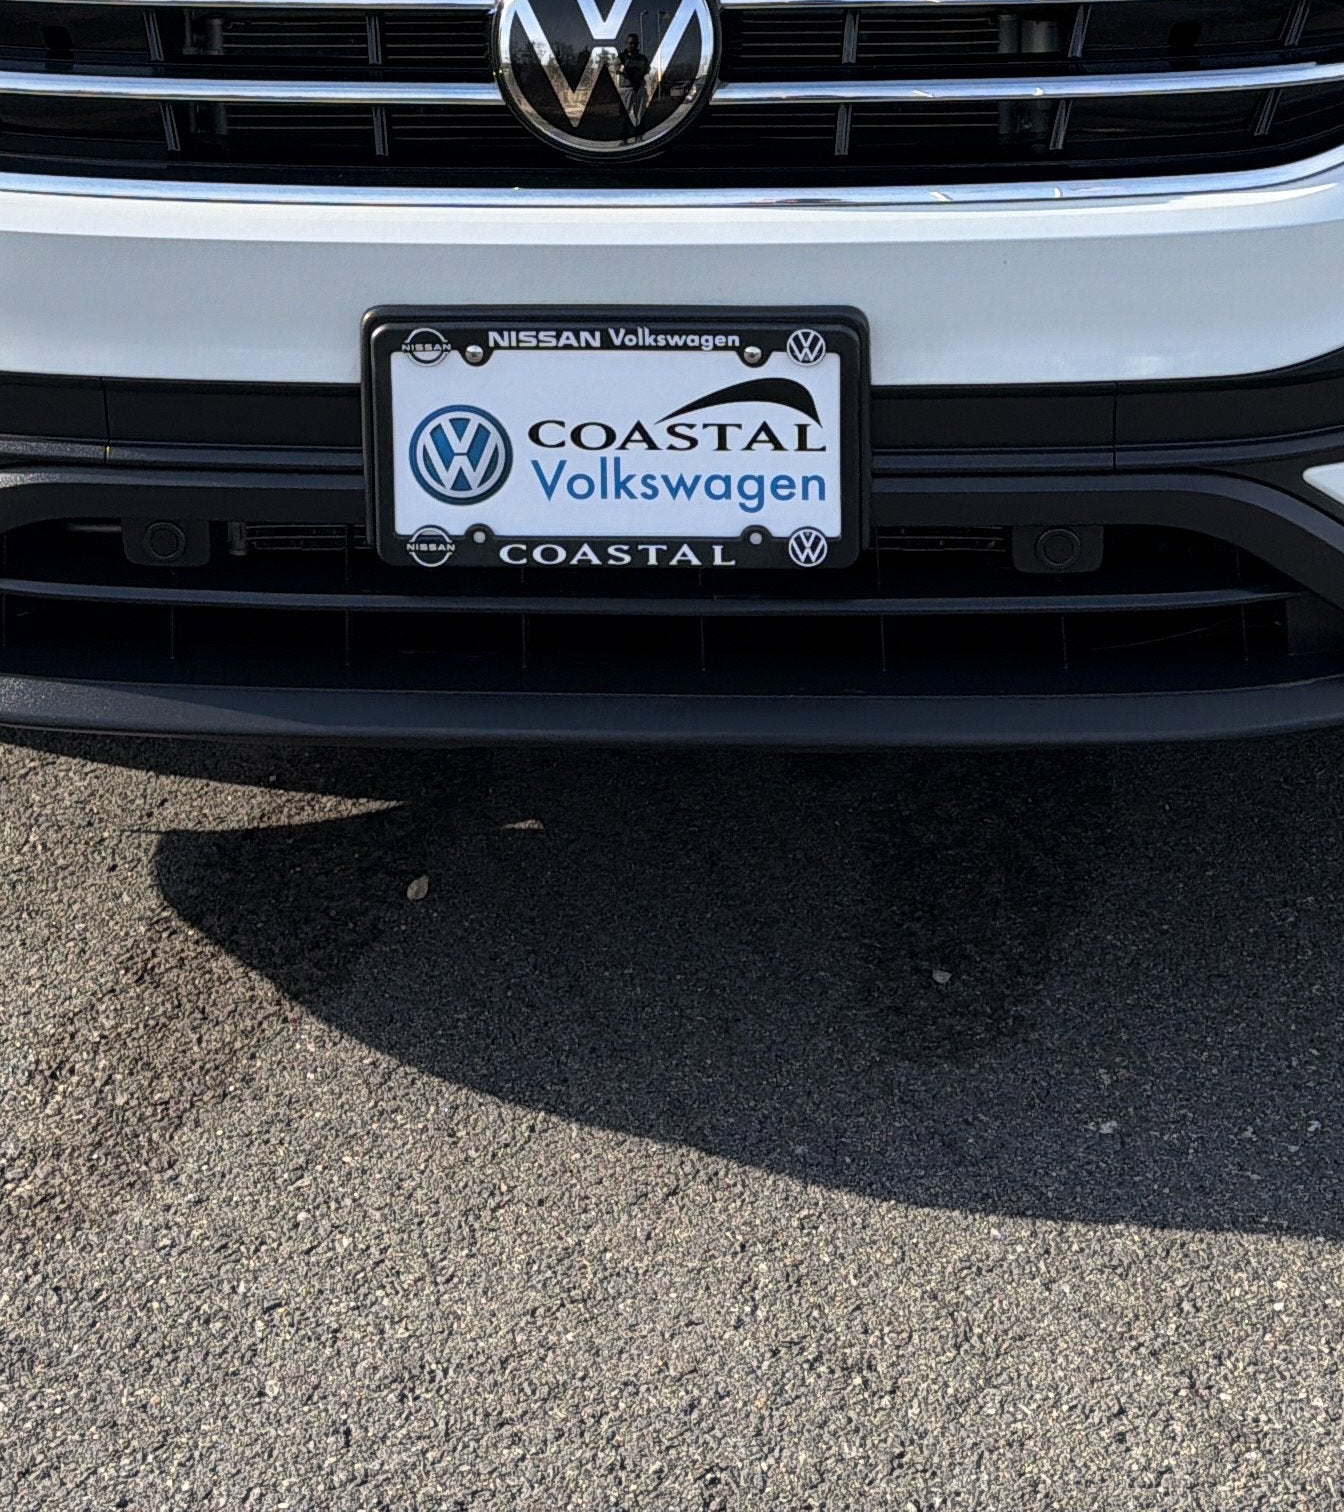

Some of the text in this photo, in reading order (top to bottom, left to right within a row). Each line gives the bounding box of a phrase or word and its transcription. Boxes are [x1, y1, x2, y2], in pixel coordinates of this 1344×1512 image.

[401, 343, 451, 352] NISSAN
[488, 326, 740, 351] NISSAN Volkswagen
[527, 420, 827, 452] COASTAL
[530, 456, 827, 514] Volkswagen
[406, 543, 455, 552] NISSAN
[499, 543, 736, 565] COASTAL
